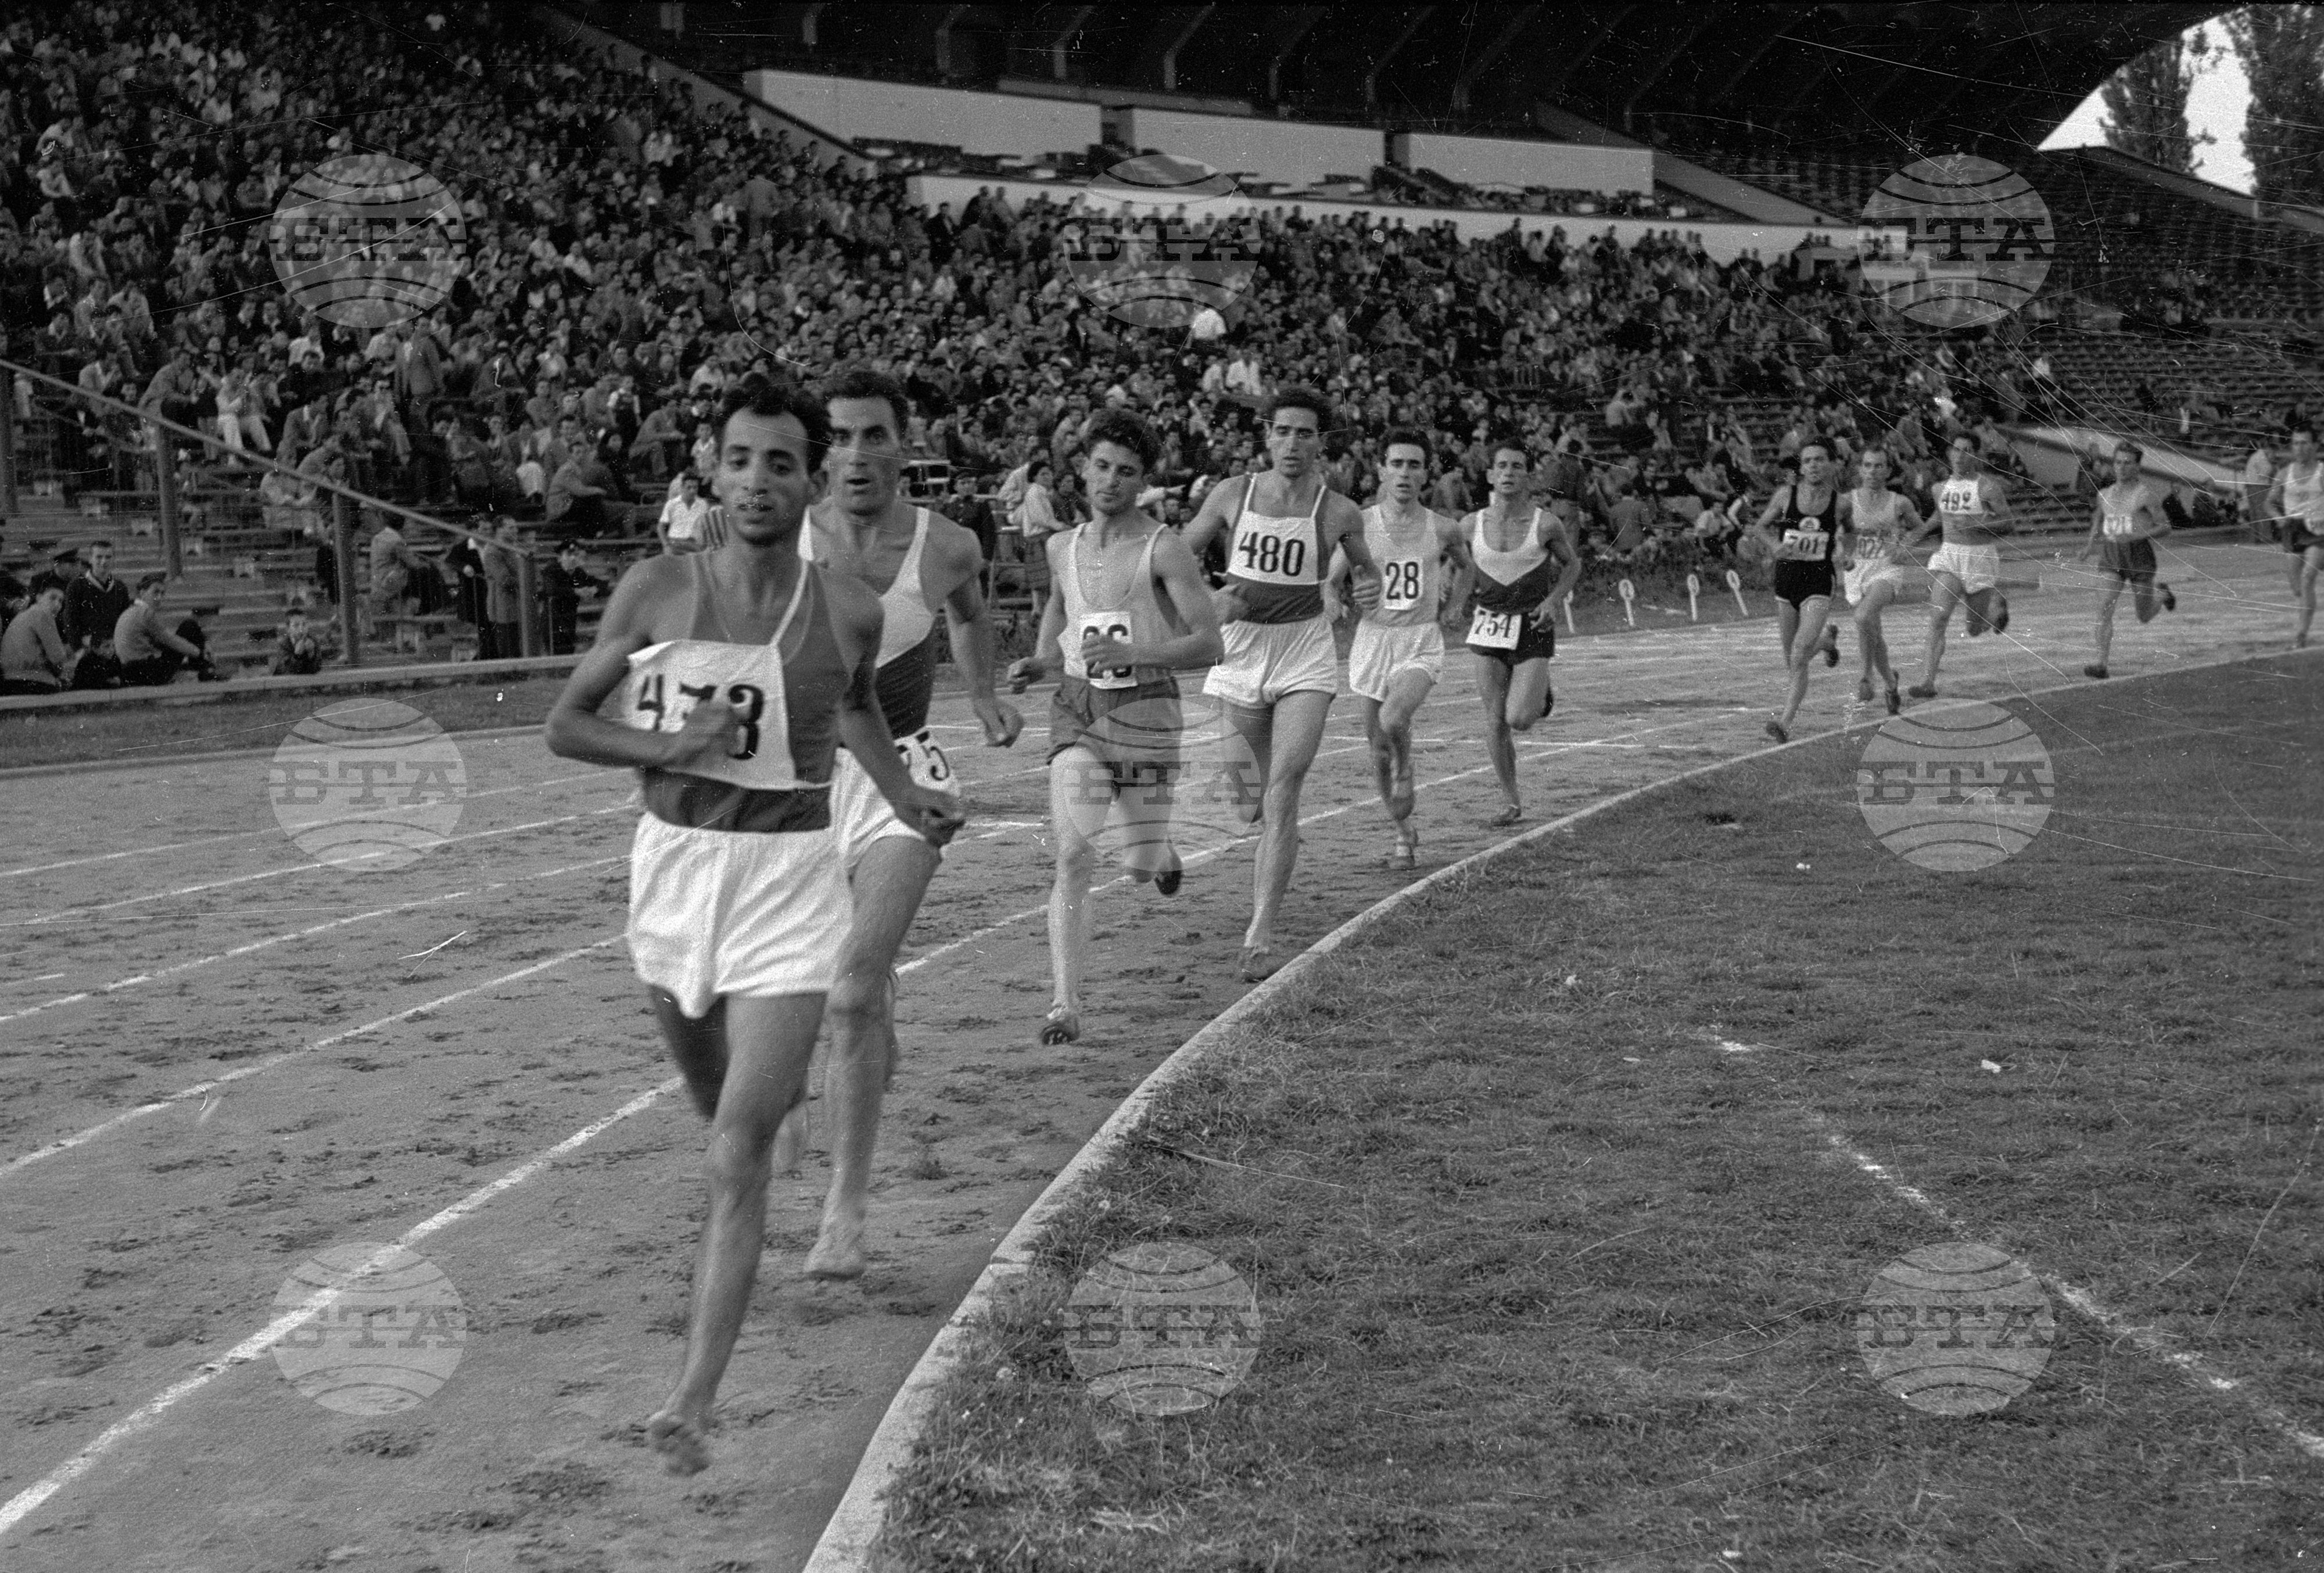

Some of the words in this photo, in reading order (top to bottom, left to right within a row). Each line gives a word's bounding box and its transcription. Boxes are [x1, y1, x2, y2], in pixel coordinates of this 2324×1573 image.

[1238, 531, 1305, 577] 480
[1386, 561, 1419, 600] 28
[1474, 610, 1511, 638] 754
